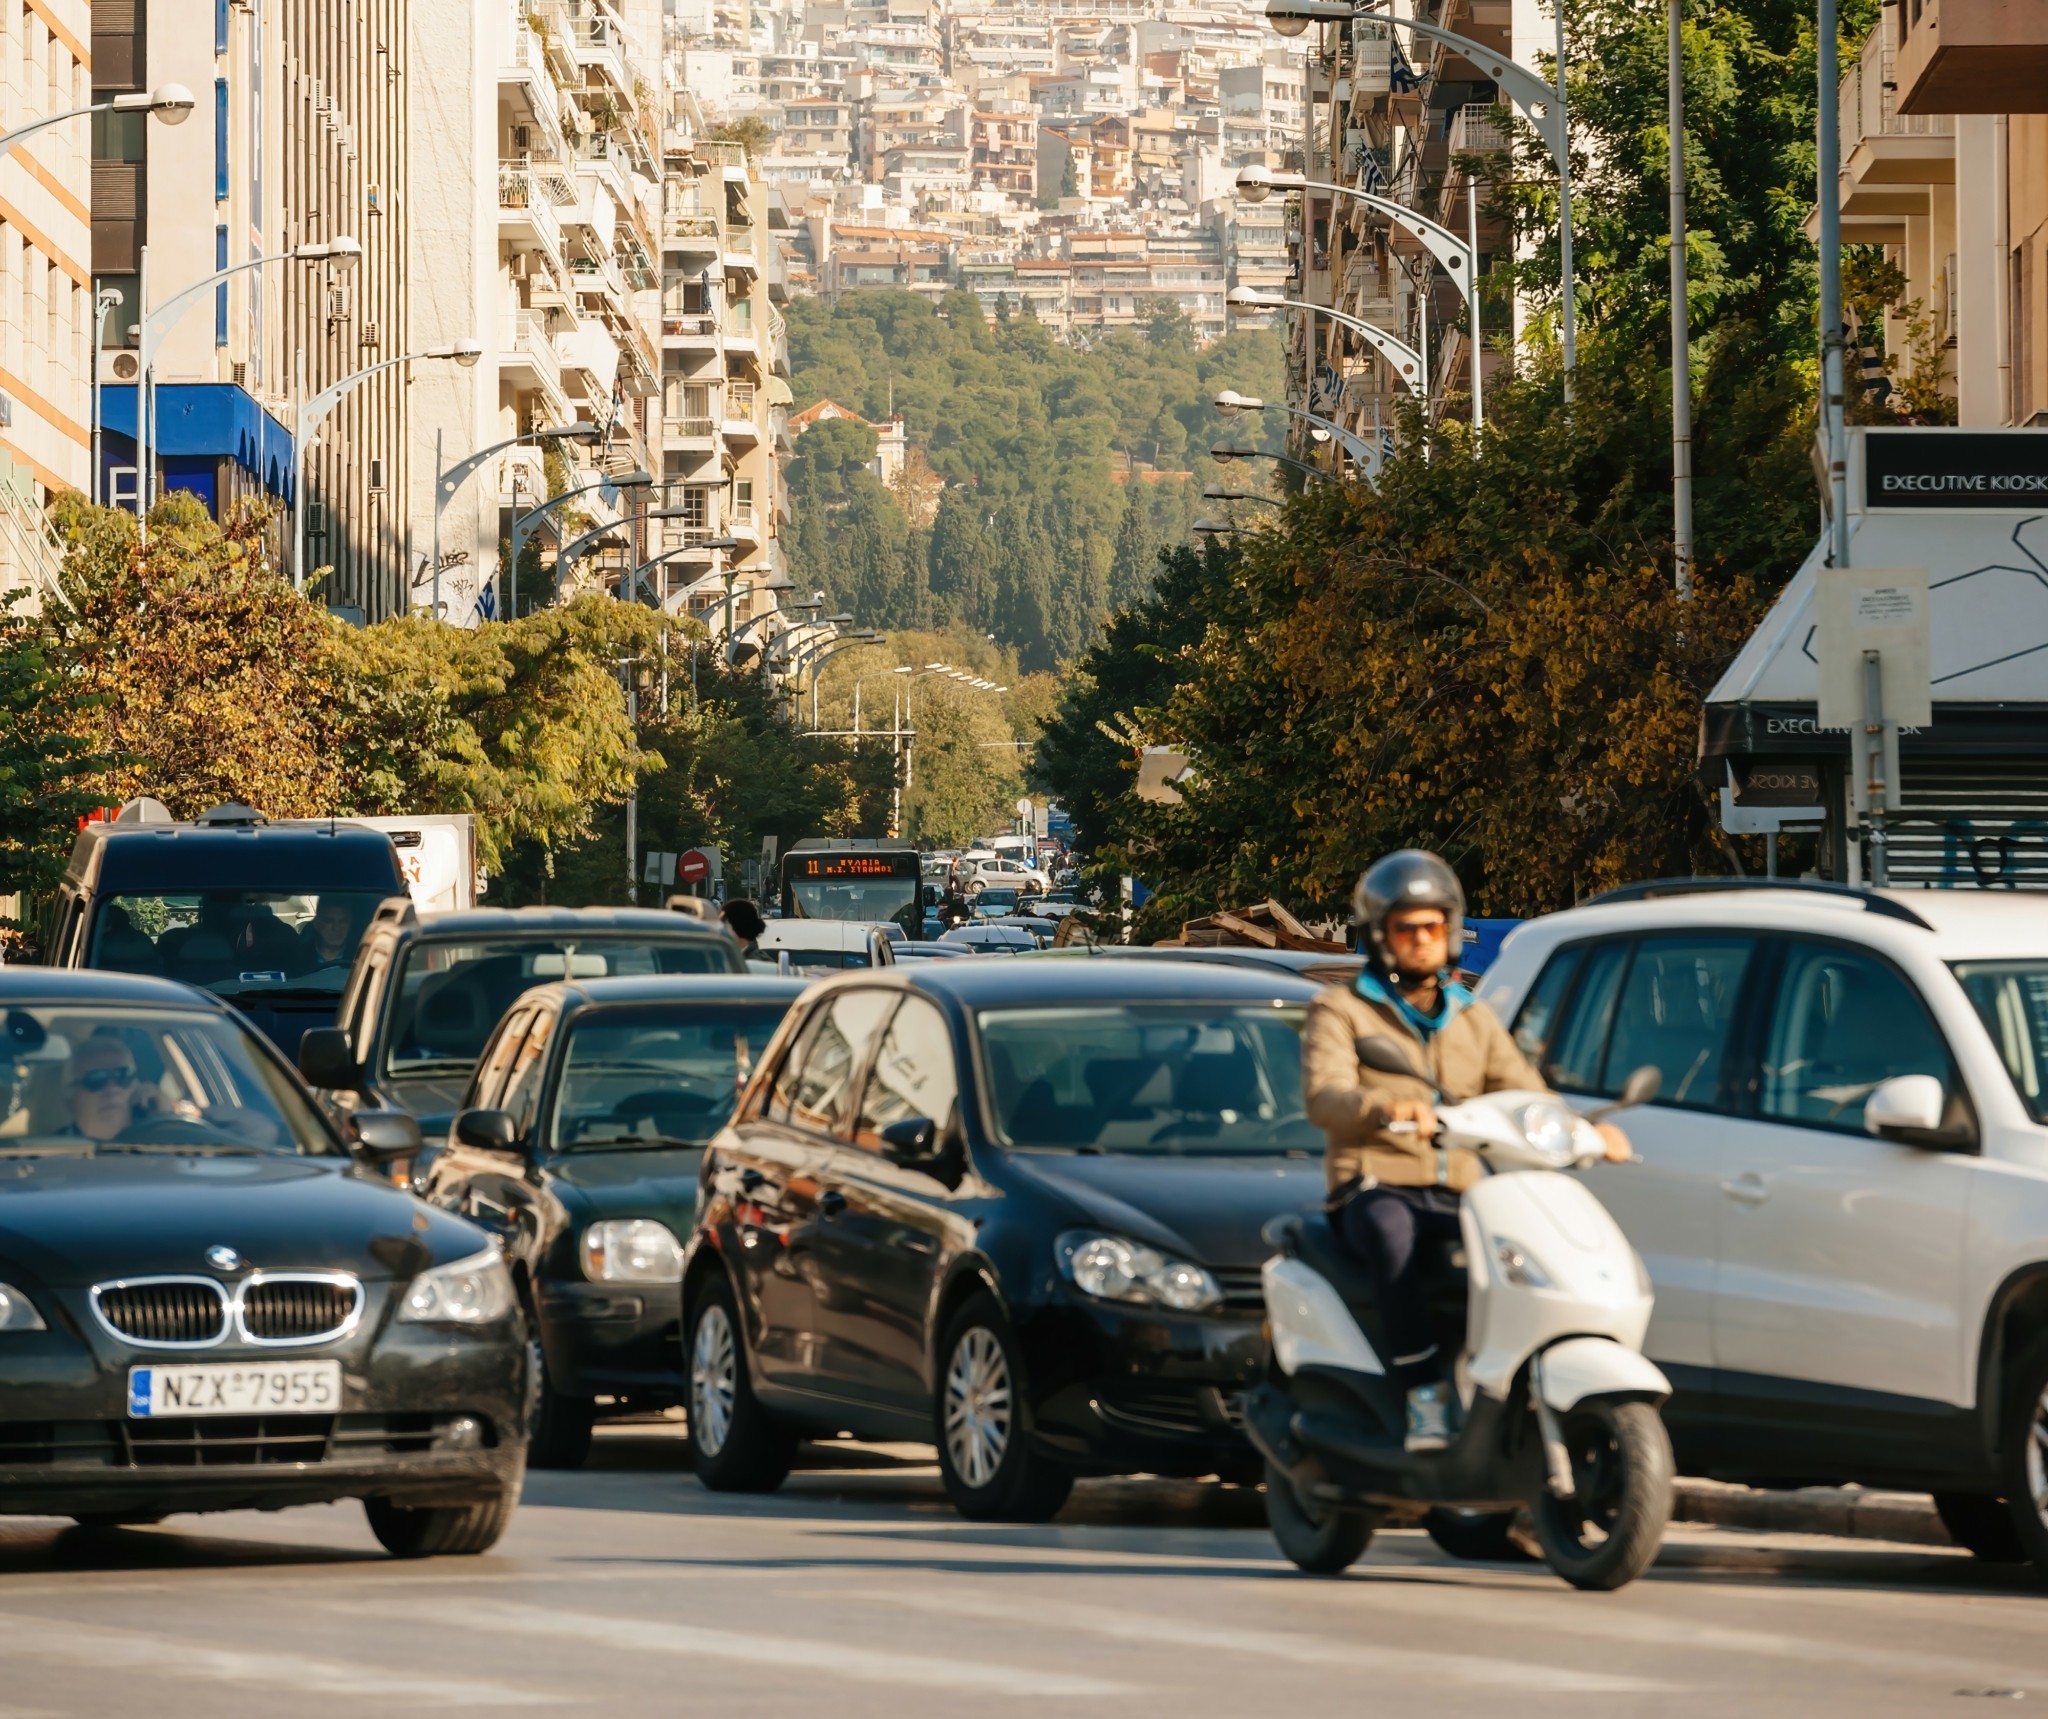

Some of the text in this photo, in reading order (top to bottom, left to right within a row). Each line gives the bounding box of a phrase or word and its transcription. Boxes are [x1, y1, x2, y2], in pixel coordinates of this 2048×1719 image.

[1883, 474, 2048, 491] EXECUTIVE KIOSK
[1767, 718, 1851, 735] EXECU
[808, 860, 819, 874] 11
[249, 1372, 330, 1404] 7955
